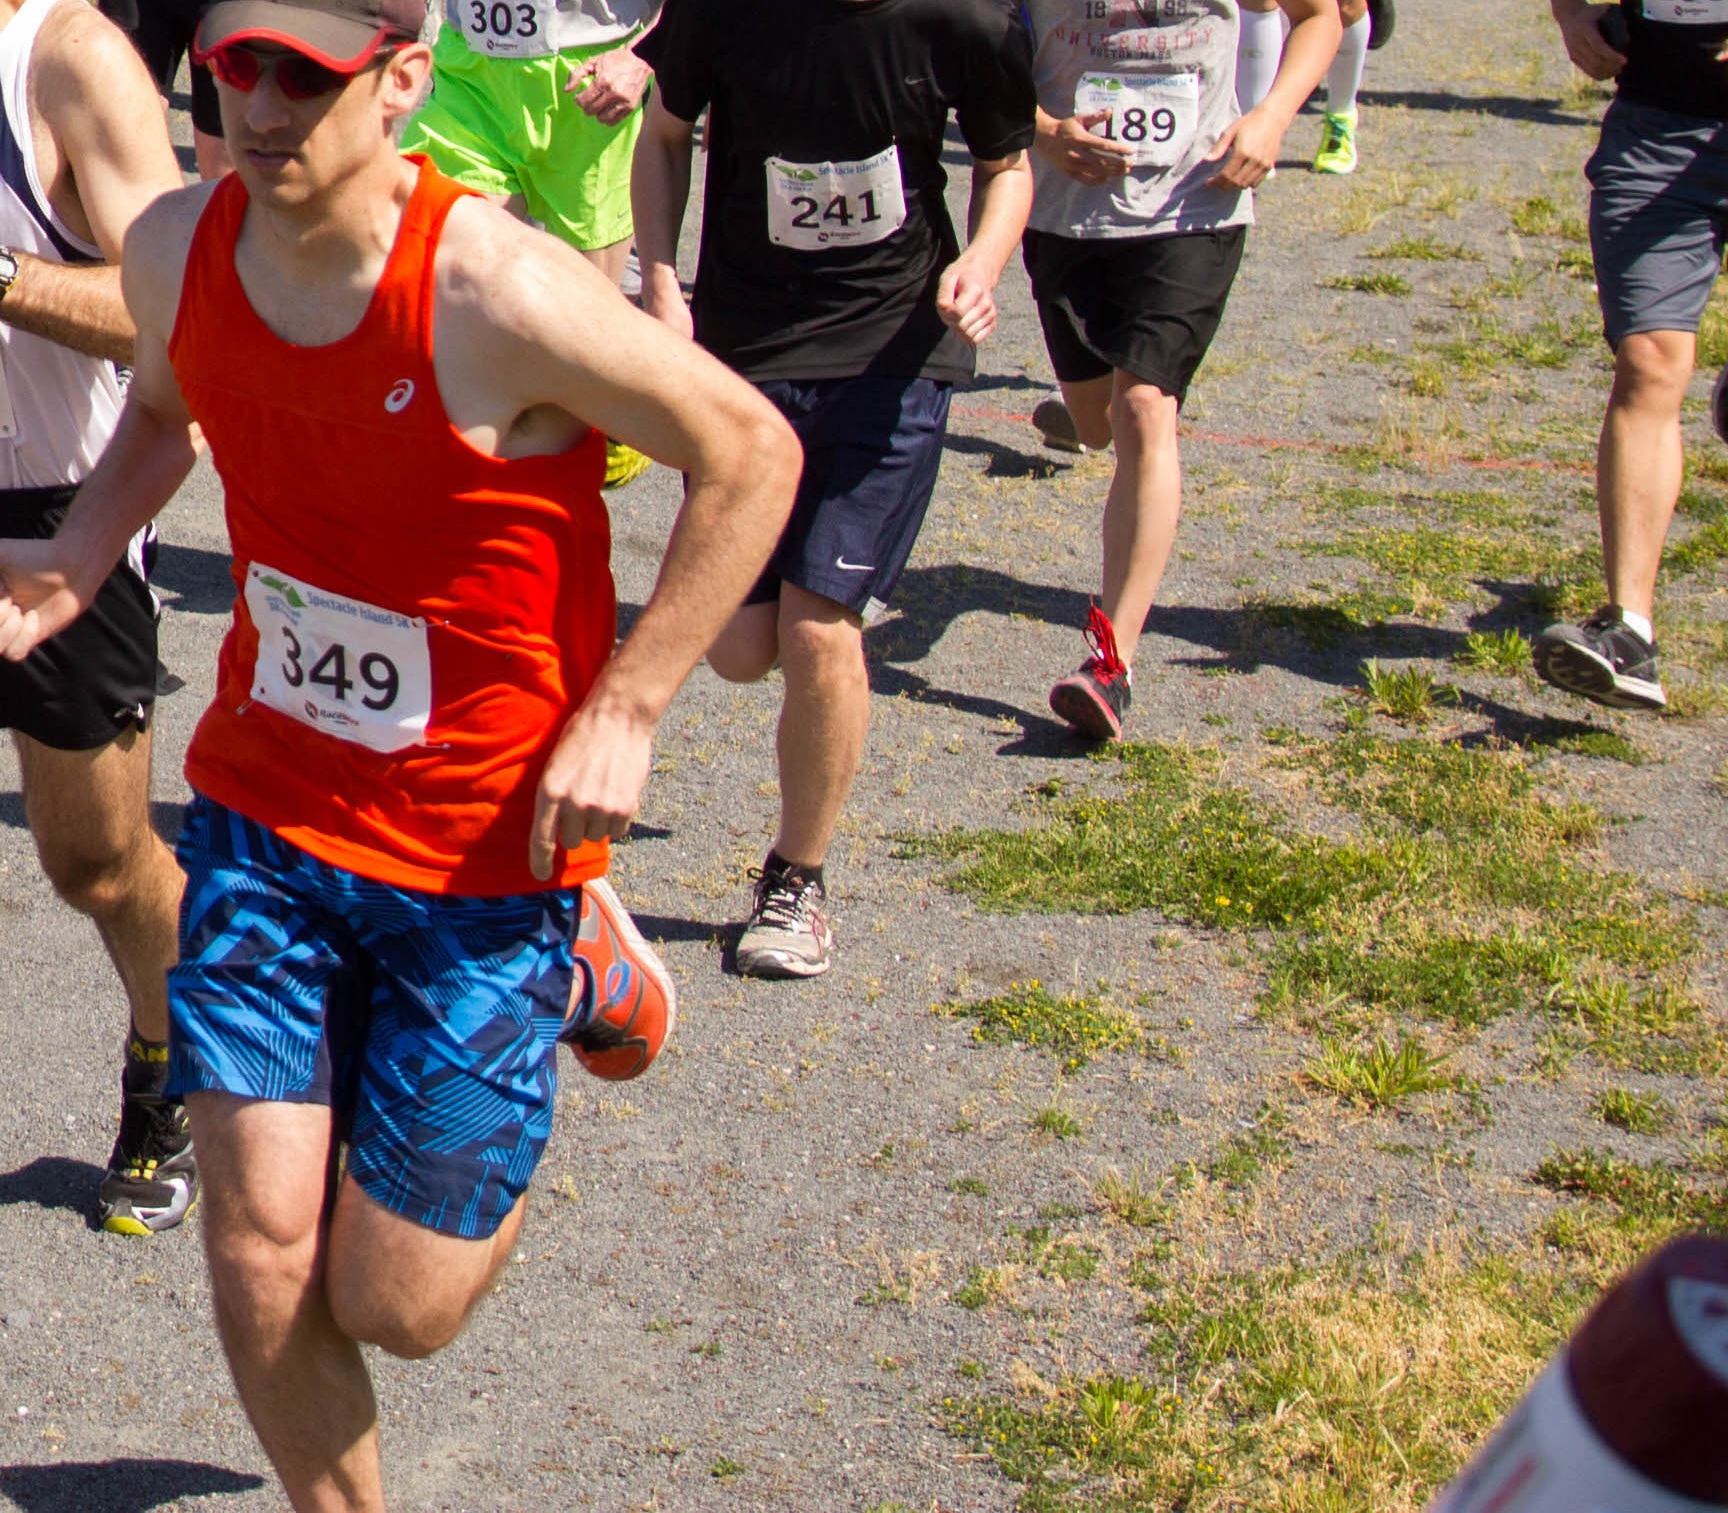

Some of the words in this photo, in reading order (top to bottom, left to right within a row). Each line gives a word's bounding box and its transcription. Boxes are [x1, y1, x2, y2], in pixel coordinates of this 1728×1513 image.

[470, 0, 538, 37] 303
[1100, 107, 1176, 142] 189
[790, 189, 881, 229] 241
[306, 590, 358, 617] Spectacle
[359, 606, 393, 626] Island
[395, 615, 411, 629] 5K
[281, 625, 400, 712] 349
